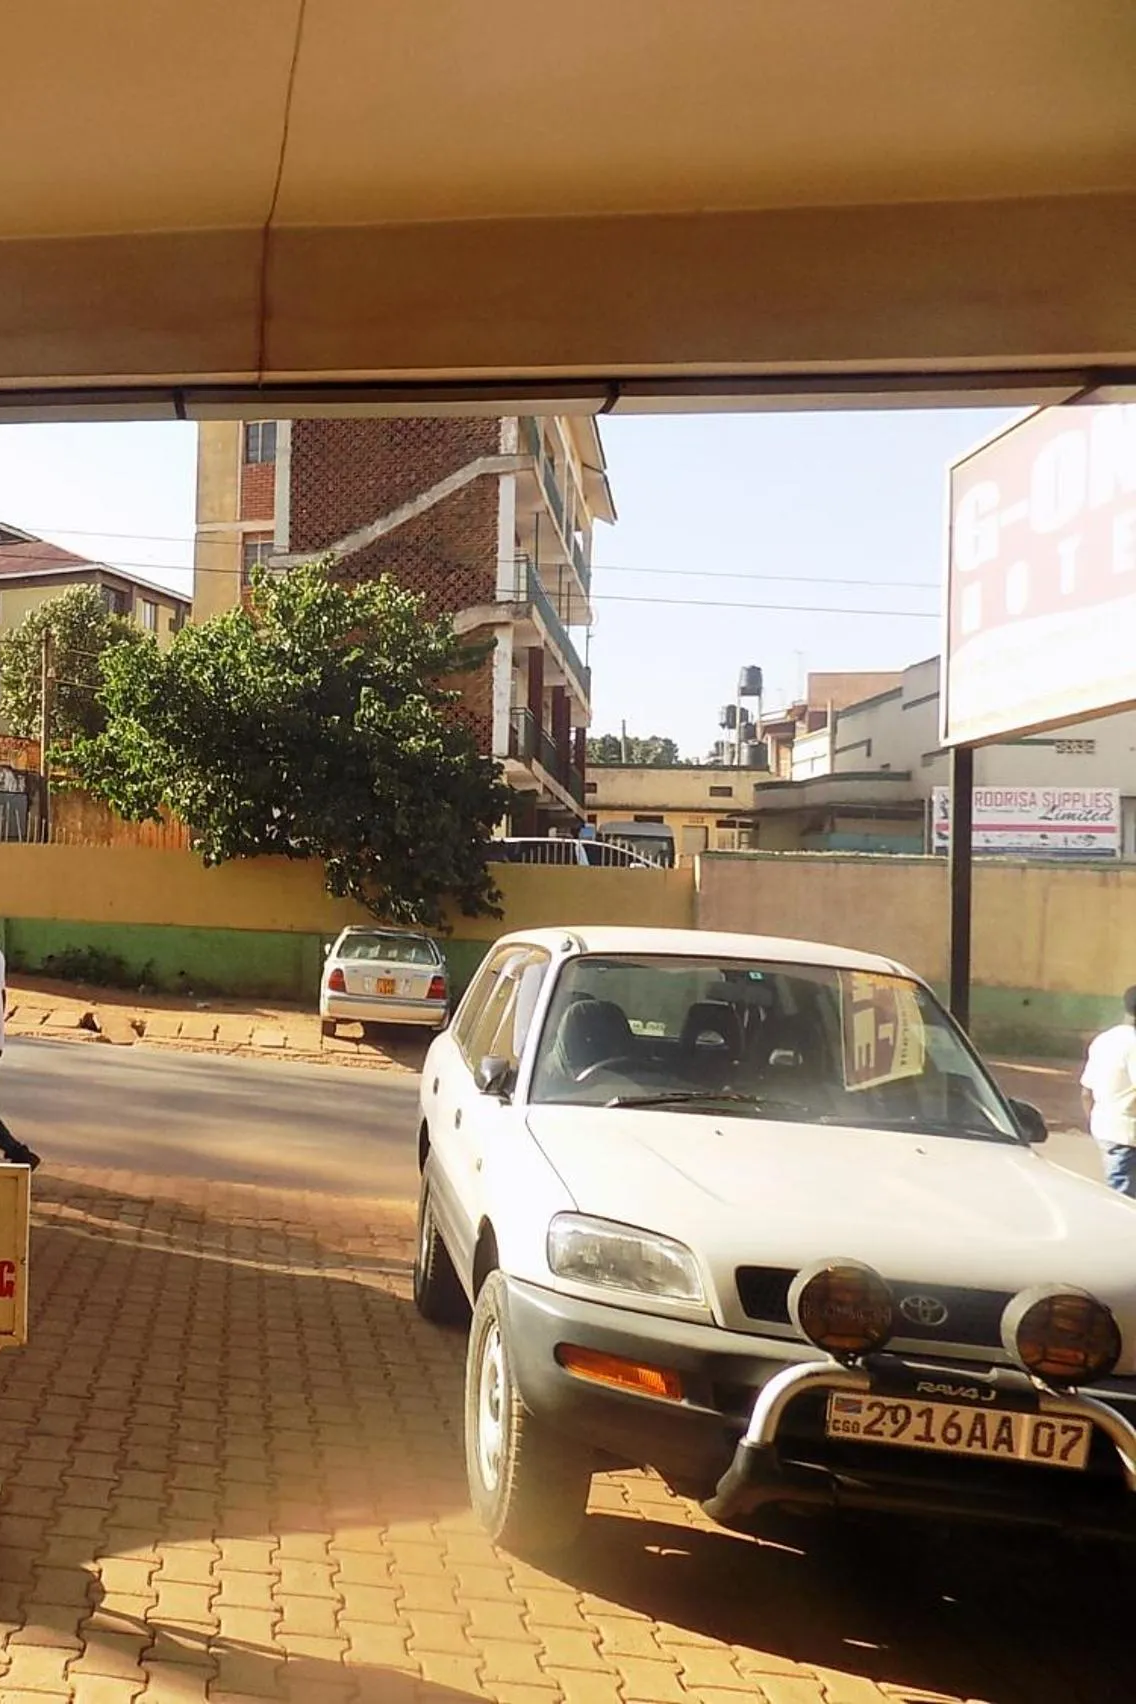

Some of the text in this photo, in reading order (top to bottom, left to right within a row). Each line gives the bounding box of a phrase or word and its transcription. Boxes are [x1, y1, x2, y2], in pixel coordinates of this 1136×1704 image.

[1042, 792, 1113, 808] SUPPLIES
[1038, 804, 1114, 821] Limited
[863, 1401, 1084, 1462] 2916AA 07
